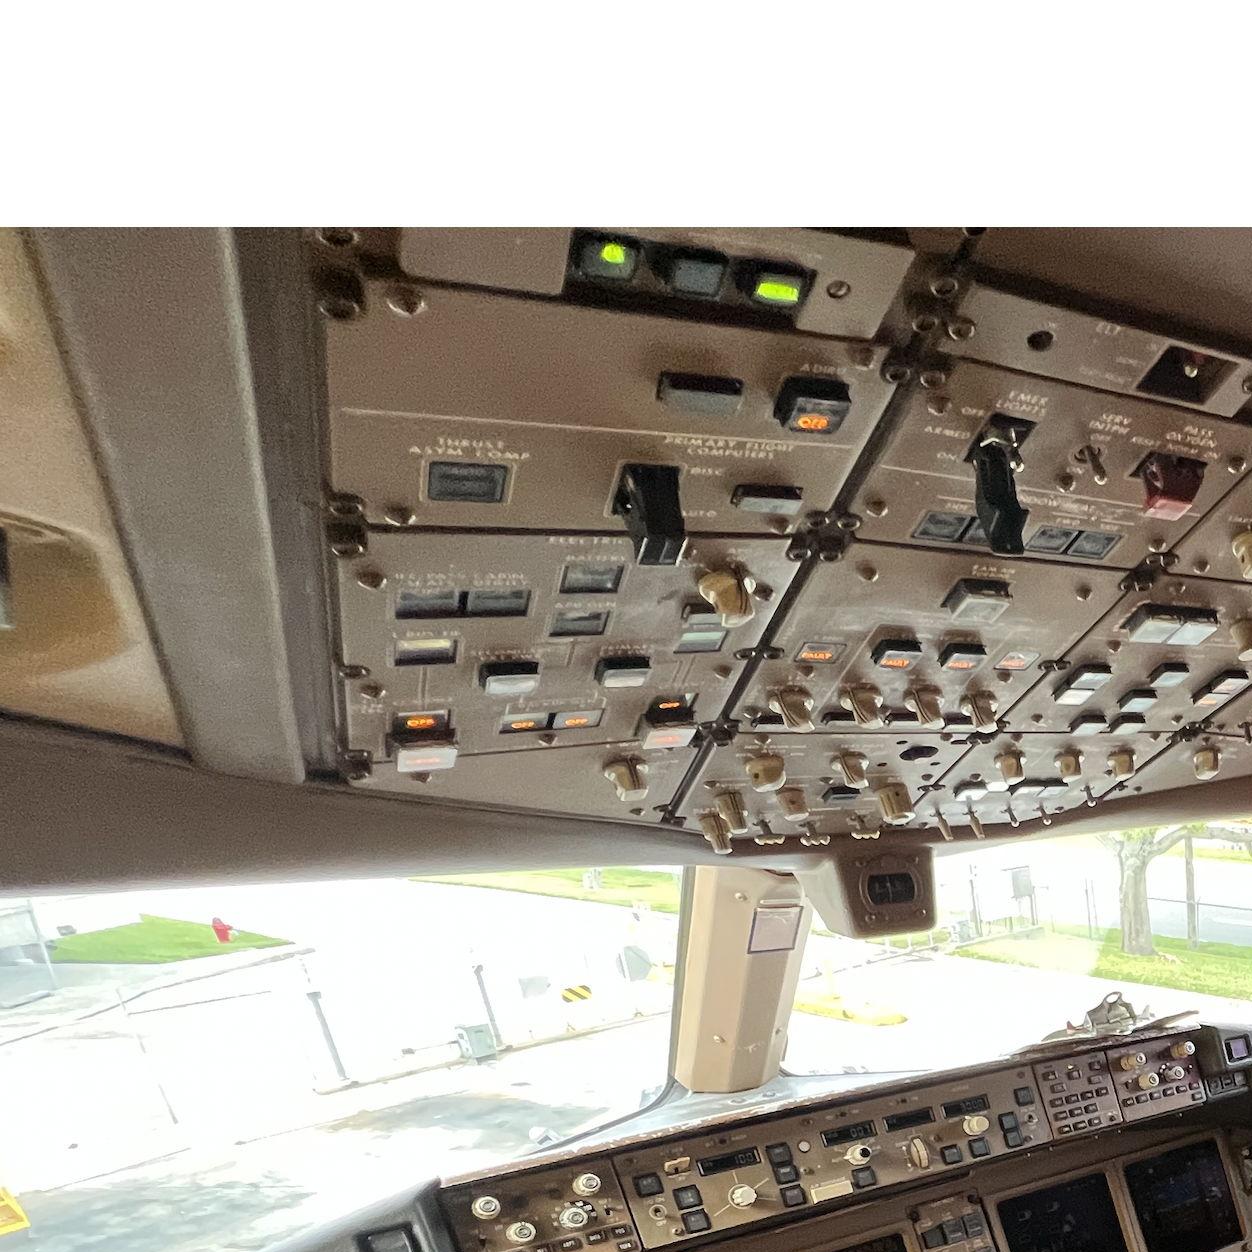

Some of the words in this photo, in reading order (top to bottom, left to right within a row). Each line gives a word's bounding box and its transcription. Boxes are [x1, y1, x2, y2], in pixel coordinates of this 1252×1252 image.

[924, 426, 970, 439] ARMED
[665, 436, 736, 448] PRIMARY
[746, 440, 795, 452] FLIGHT
[687, 448, 775, 460] COMPUTERS
